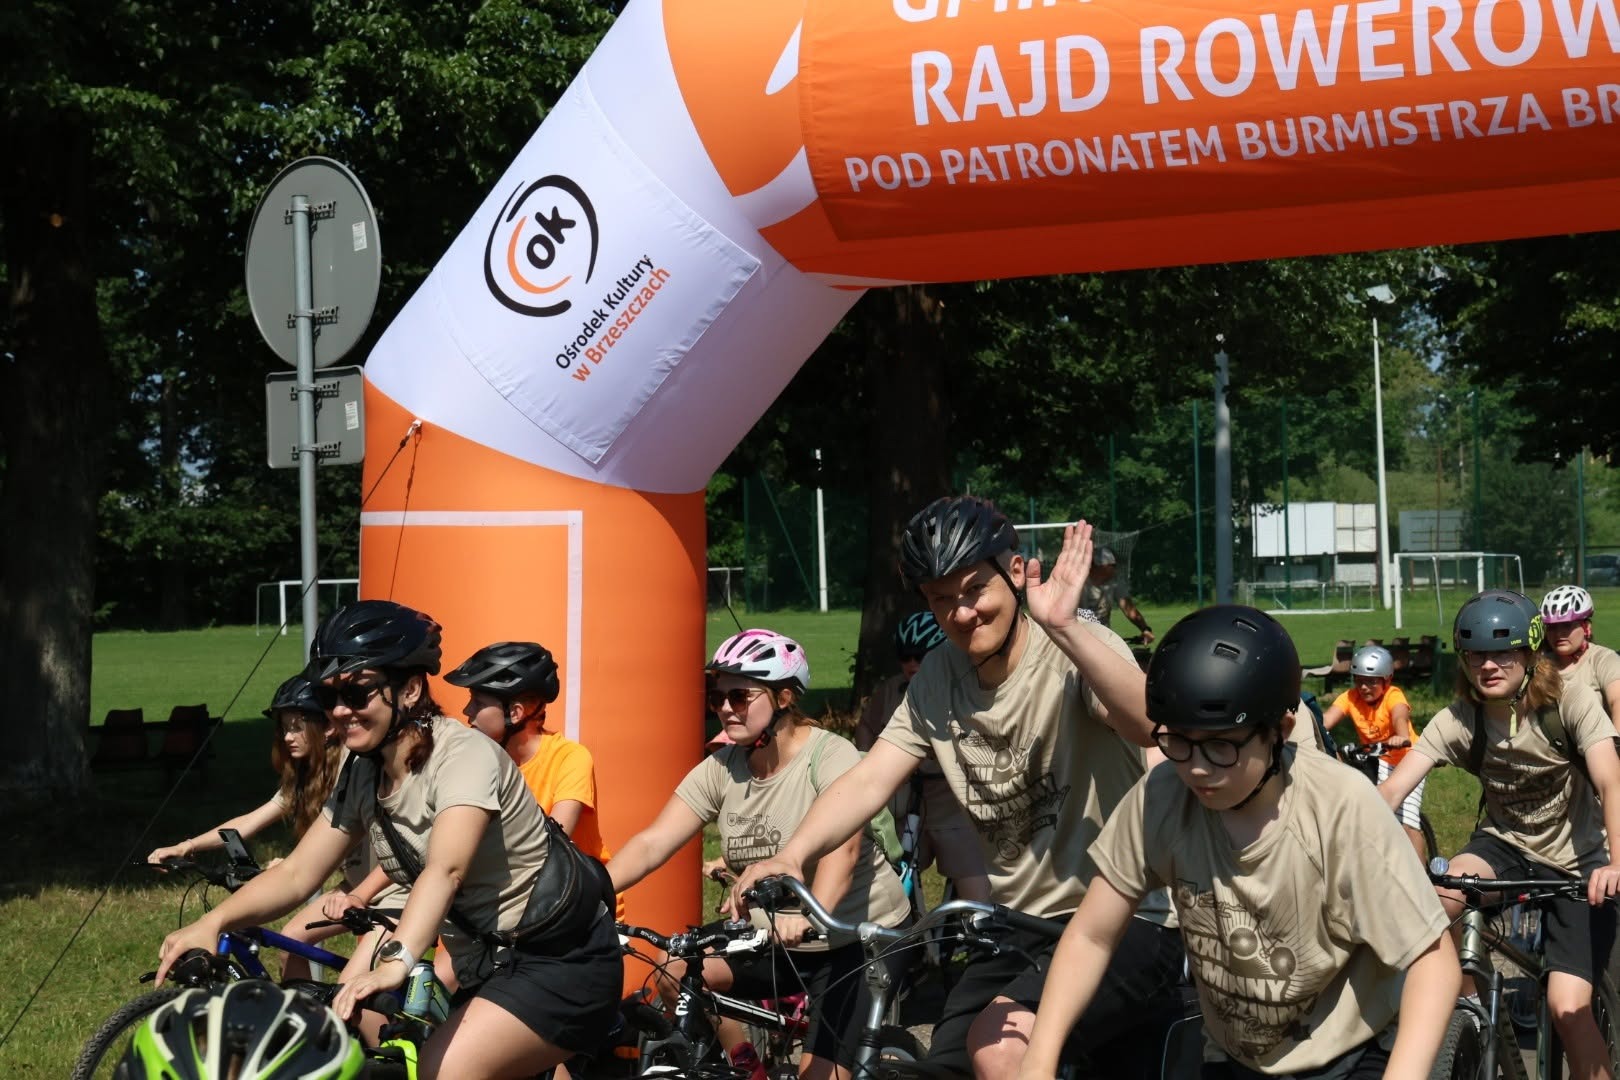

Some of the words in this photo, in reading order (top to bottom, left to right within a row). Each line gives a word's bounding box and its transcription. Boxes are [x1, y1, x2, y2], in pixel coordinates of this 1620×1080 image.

[909, 33, 1111, 126] RAJD
[844, 151, 932, 192] POD
[939, 125, 1227, 185] PATRONATEM
[1235, 93, 1552, 160] BURMISTRZA
[555, 308, 610, 369] Ośrodek
[603, 254, 655, 310] Kultury
[572, 363, 592, 382] w
[584, 266, 671, 364] Brzeszczach
[729, 845, 777, 861] GMINNY
